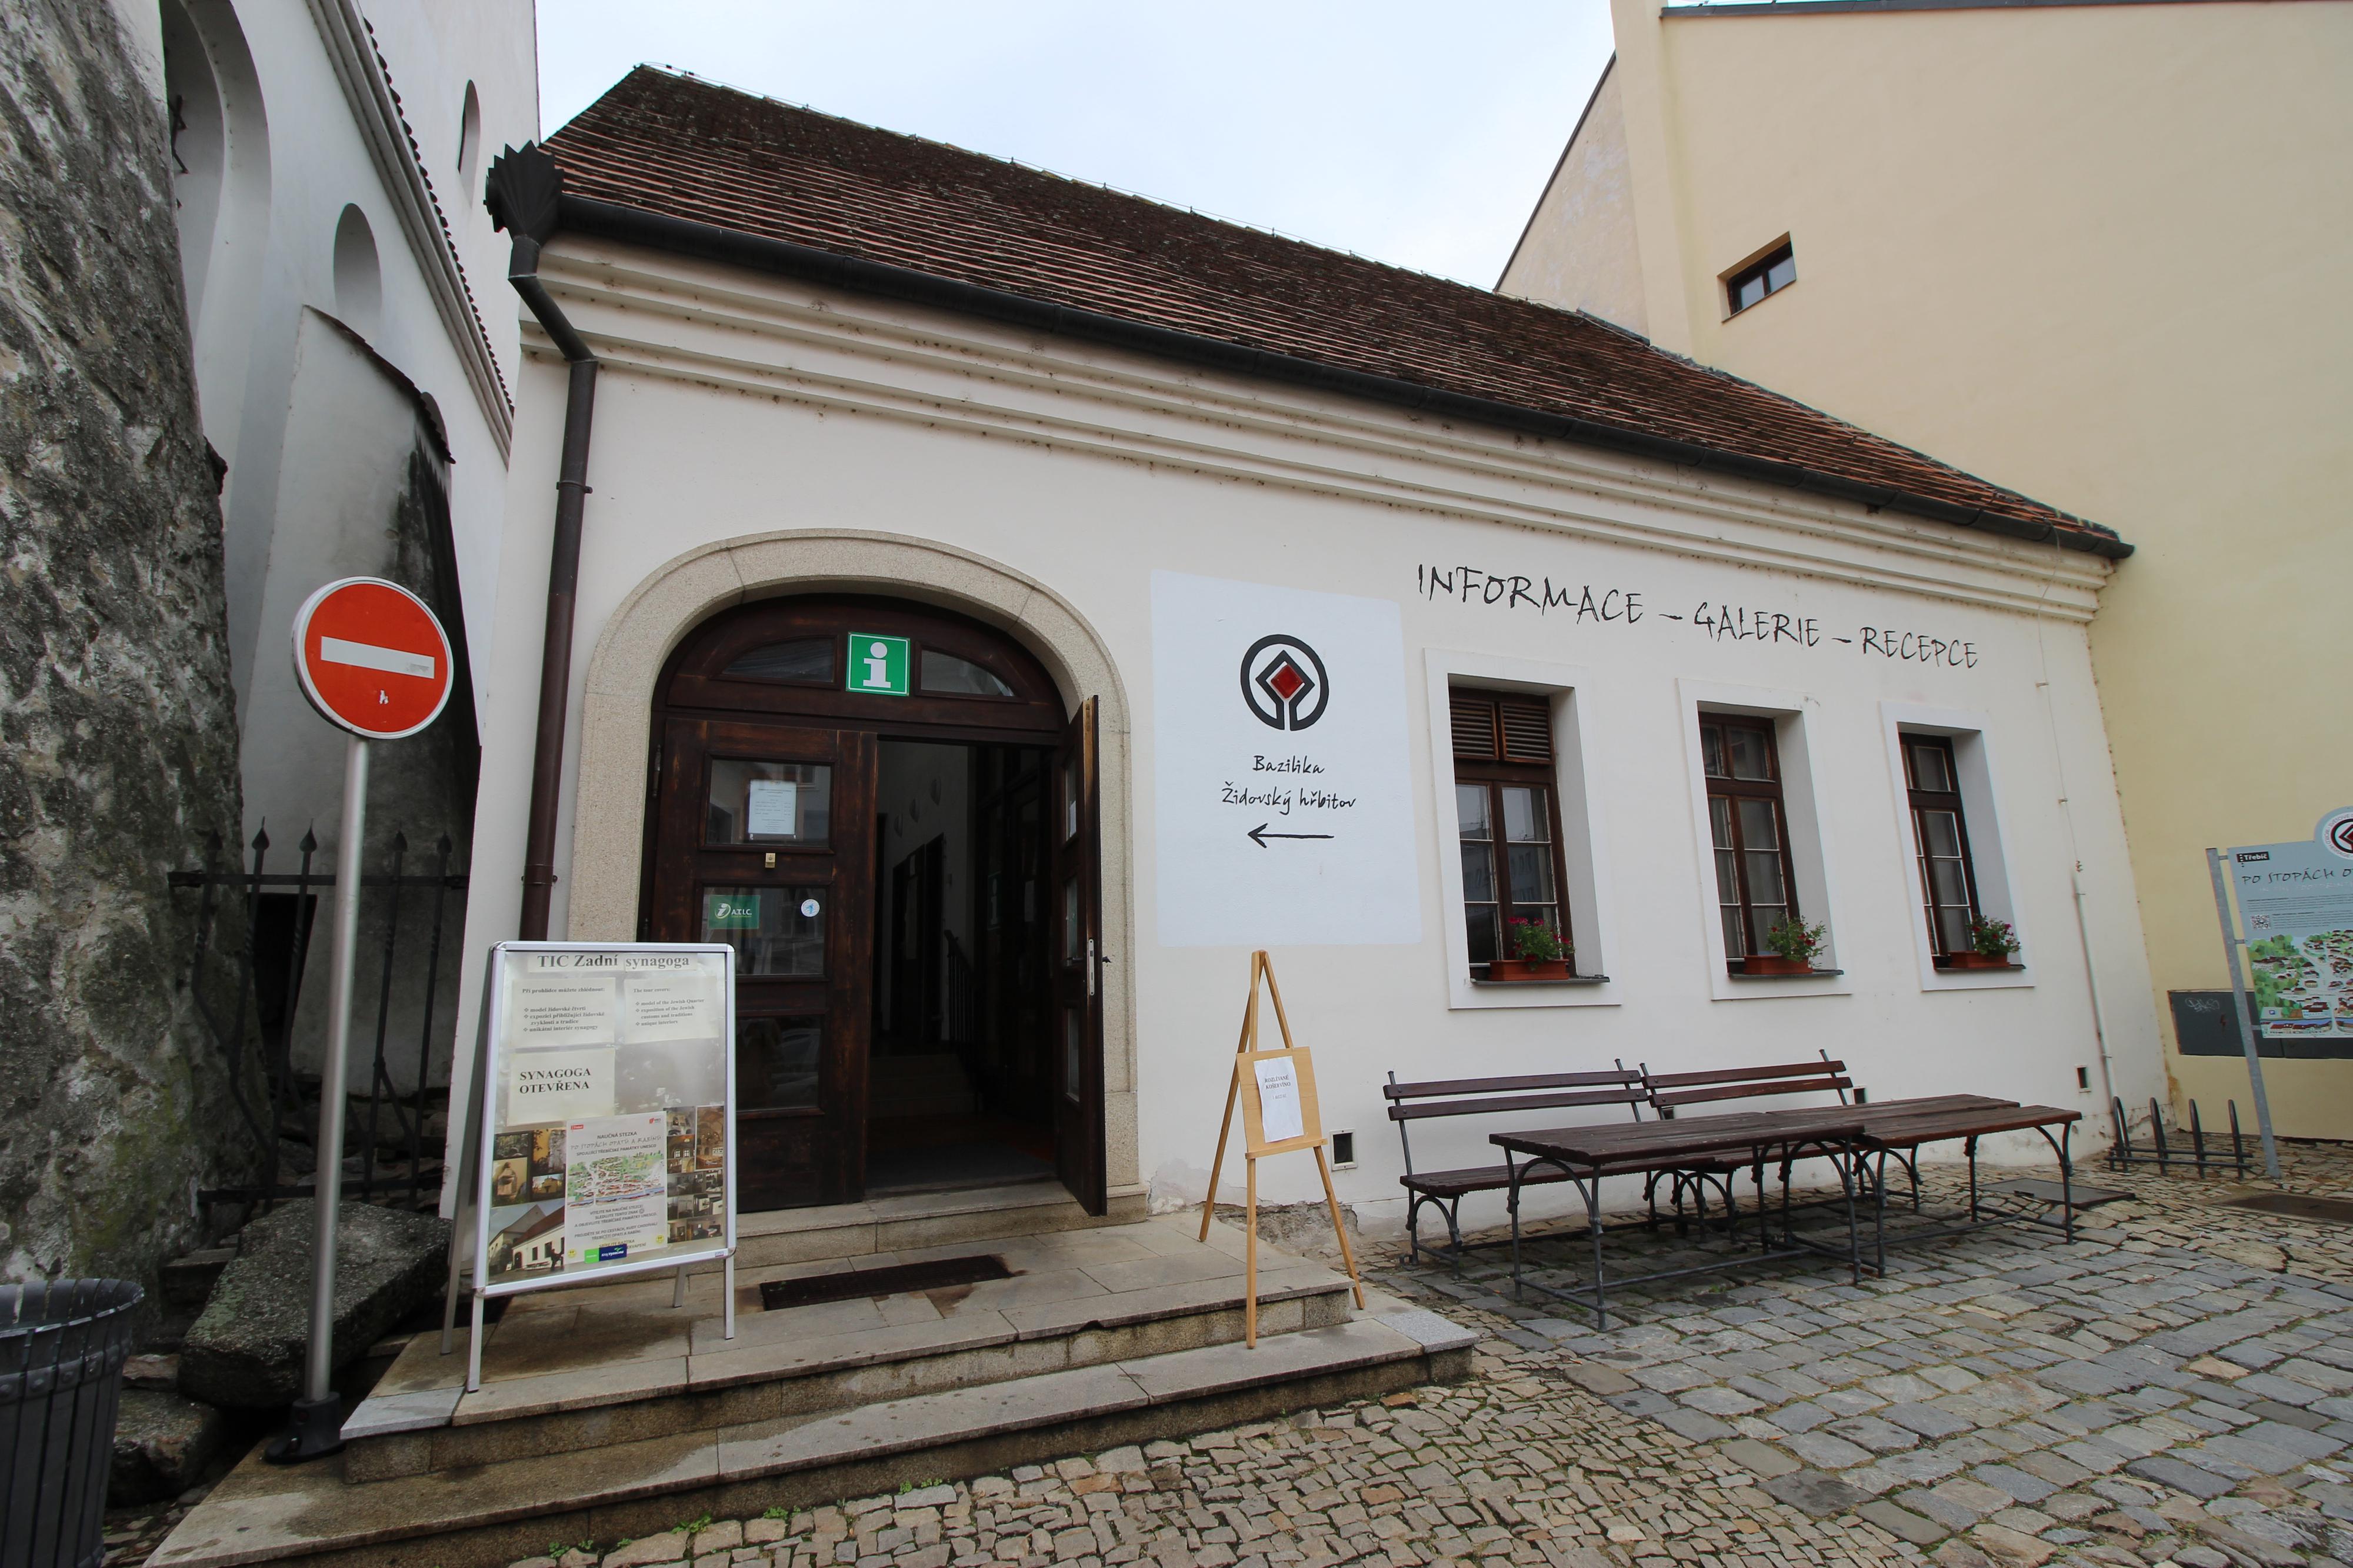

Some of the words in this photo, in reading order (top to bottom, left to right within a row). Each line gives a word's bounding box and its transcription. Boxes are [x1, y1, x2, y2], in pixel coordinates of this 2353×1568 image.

[1418, 563, 1643, 625] INFORMACE
[1694, 602, 1819, 647] GALERIE
[1860, 626, 1978, 668] RECEPCE
[1252, 755, 1325, 774] Bazilika
[1222, 781, 1291, 815] Židovský
[1299, 788, 1356, 809] hřbitov
[2242, 875, 2261, 885] PO
[2268, 868, 2334, 883] STOPÁCH
[538, 955, 569, 968] TIC
[574, 954, 618, 967] Zadní
[625, 957, 689, 969] synagoga
[520, 1068, 591, 1081] SYNAGOGA
[520, 1080, 589, 1094] OTEVŘENA
